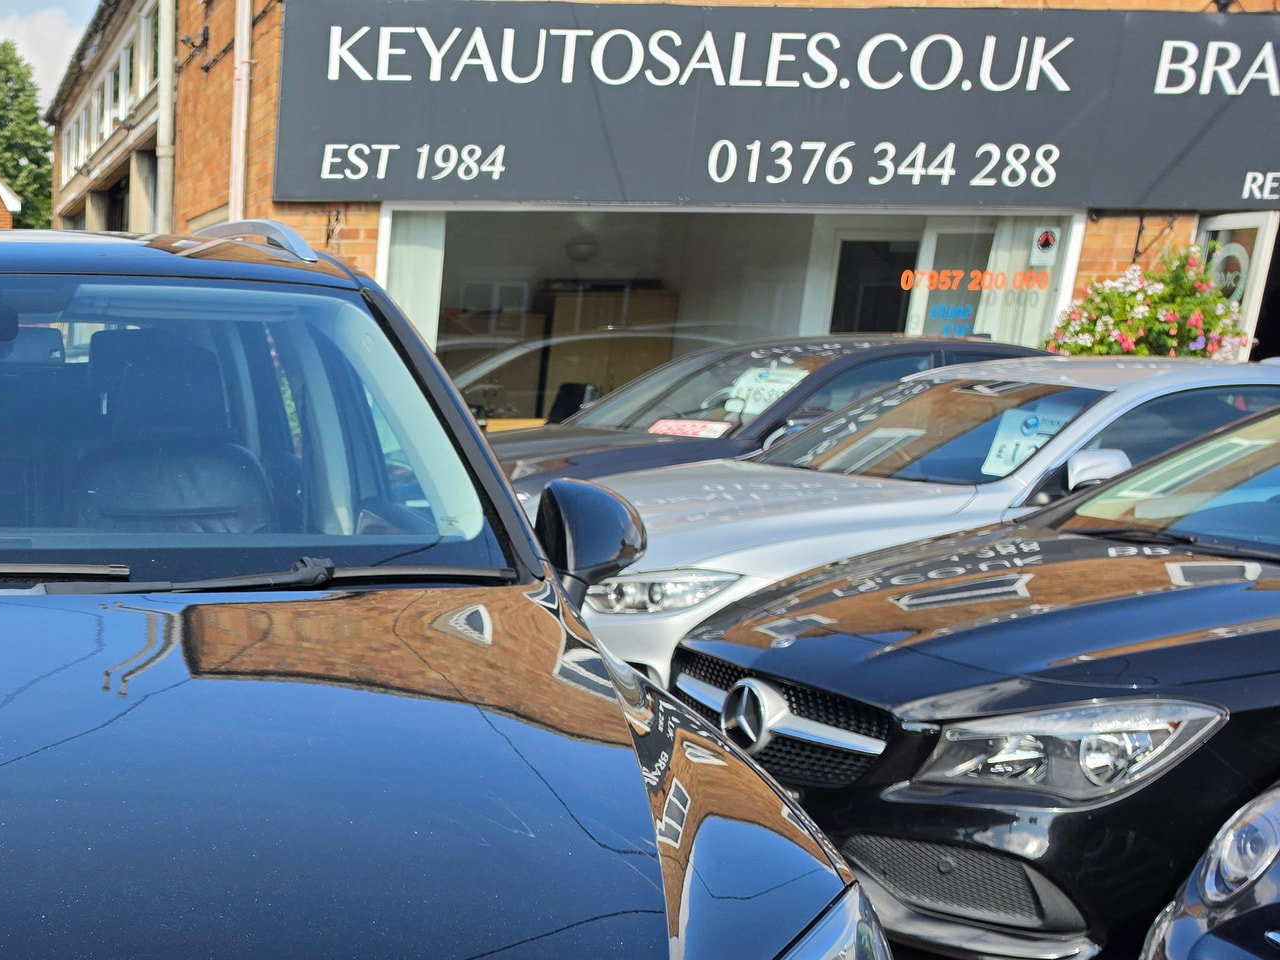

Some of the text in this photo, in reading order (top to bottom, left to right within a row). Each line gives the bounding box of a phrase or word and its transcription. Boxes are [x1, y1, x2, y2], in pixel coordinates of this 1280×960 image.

[327, 25, 1074, 93] KEYAUTOSALES.CO.UK
[1154, 40, 1280, 96] BRA
[320, 143, 507, 182] EST 1984
[707, 139, 1060, 189] 01376 344 288
